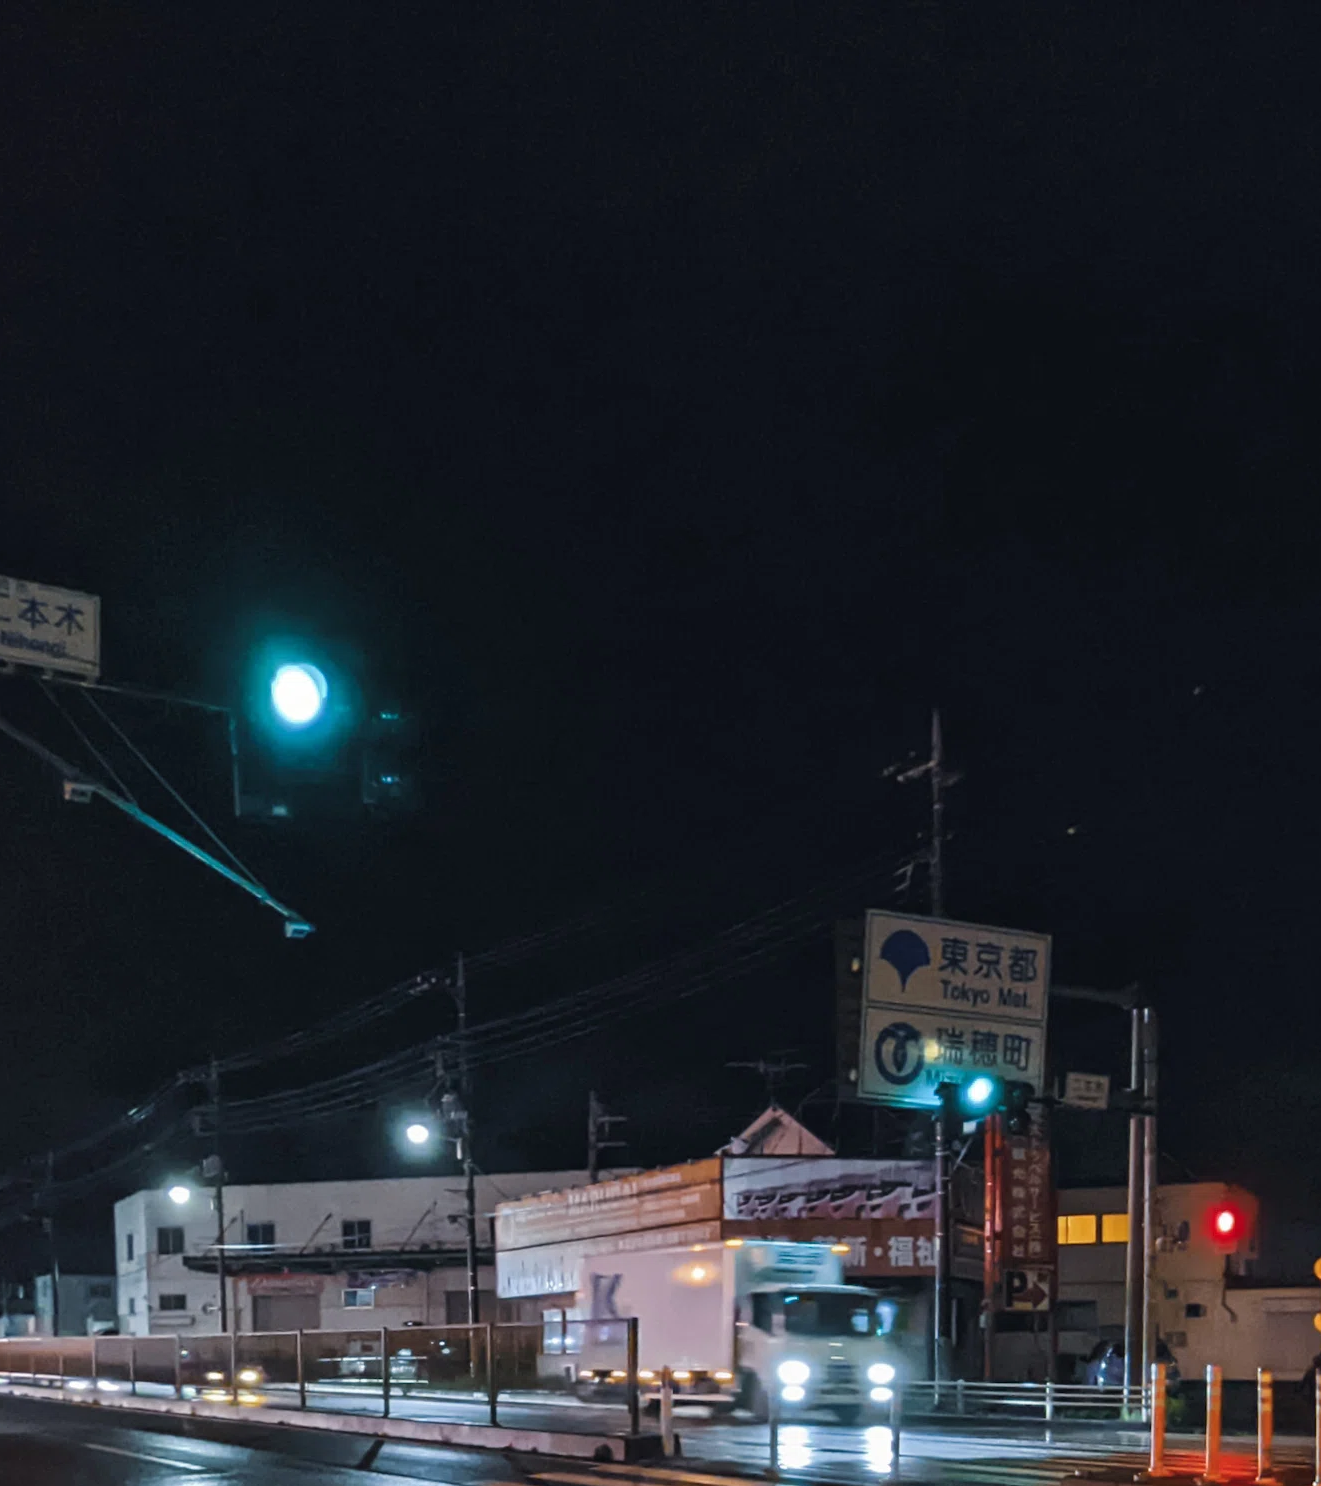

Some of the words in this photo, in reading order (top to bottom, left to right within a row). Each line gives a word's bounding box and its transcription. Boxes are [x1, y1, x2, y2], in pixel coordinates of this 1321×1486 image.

[938, 937, 1038, 983] 東京都
[940, 979, 991, 1007] Tokyo
[998, 987, 1032, 1009] Met.
[936, 1026, 1032, 1071] 瑞穂町
[1006, 1271, 1028, 1307] P
